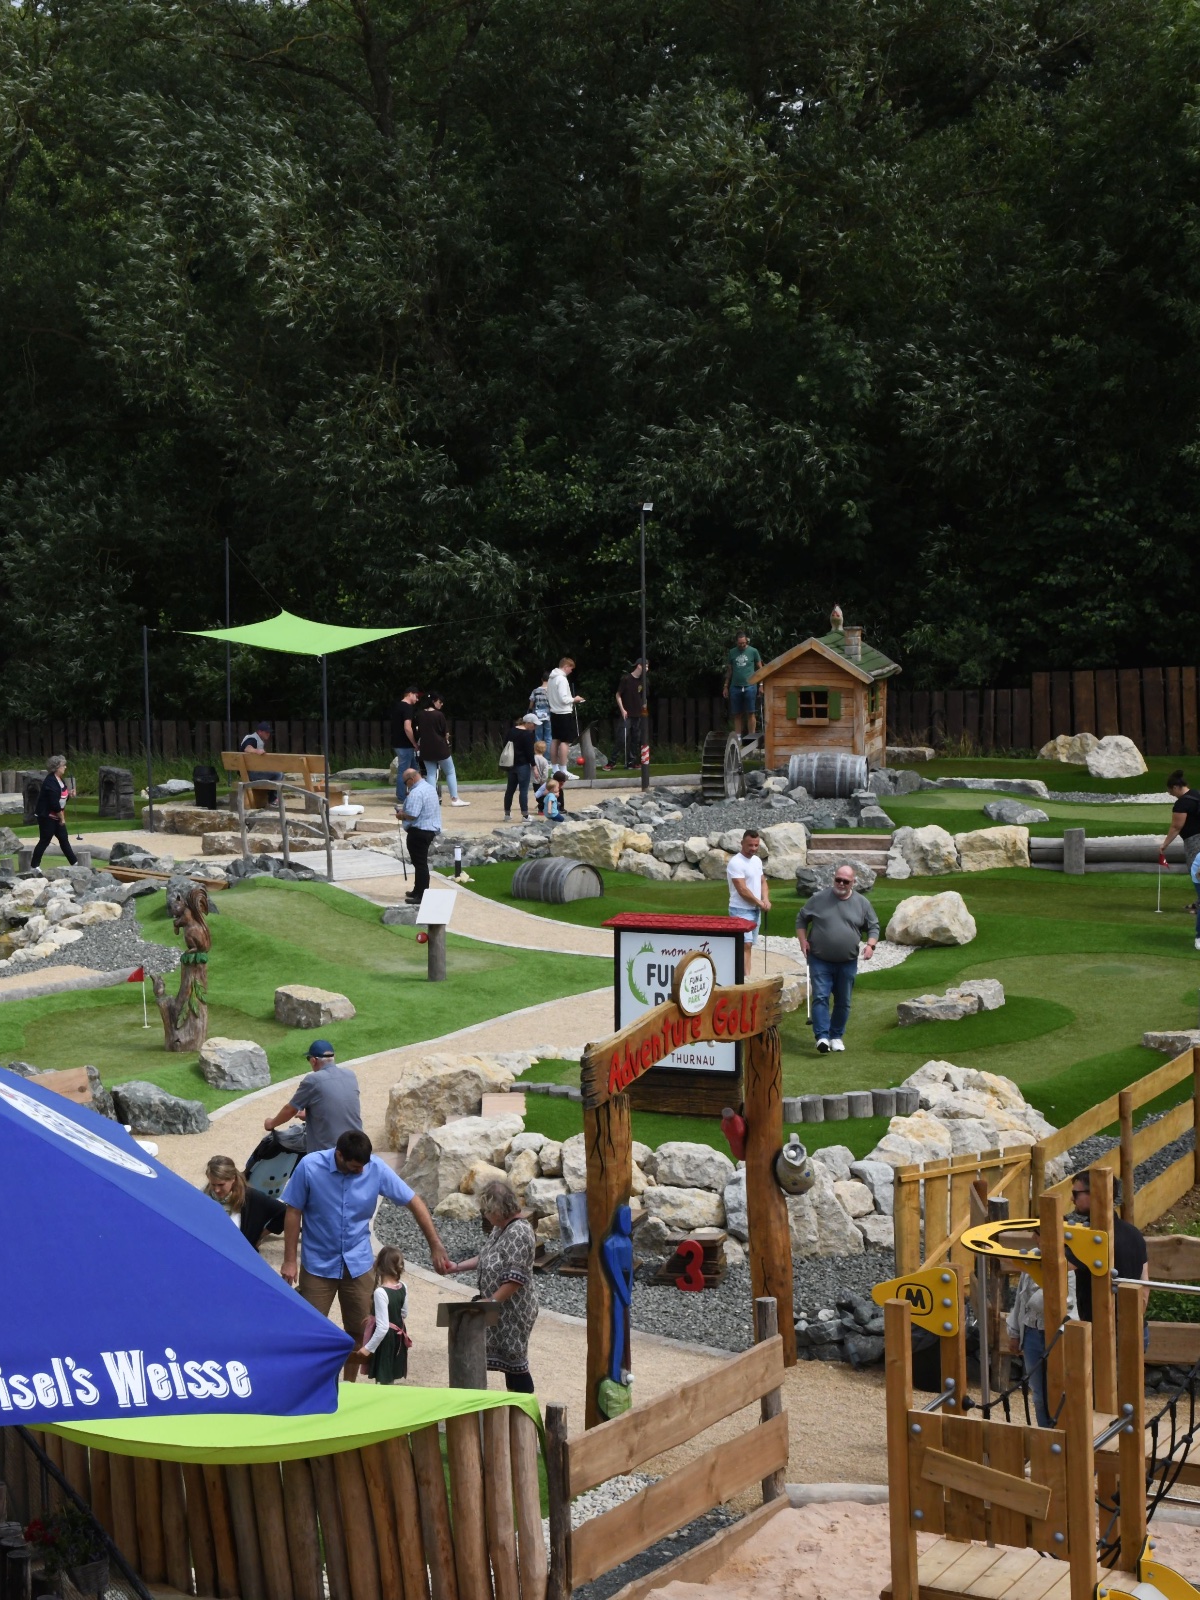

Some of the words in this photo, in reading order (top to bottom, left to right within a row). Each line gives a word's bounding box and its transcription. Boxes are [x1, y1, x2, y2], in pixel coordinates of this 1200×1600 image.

[690, 983, 706, 994] RELAX
[688, 995, 701, 1005] PARK
[608, 1015, 702, 1094] Adventure
[671, 1052, 715, 1066] THURNAU
[100, 1347, 252, 1408] Weisse
